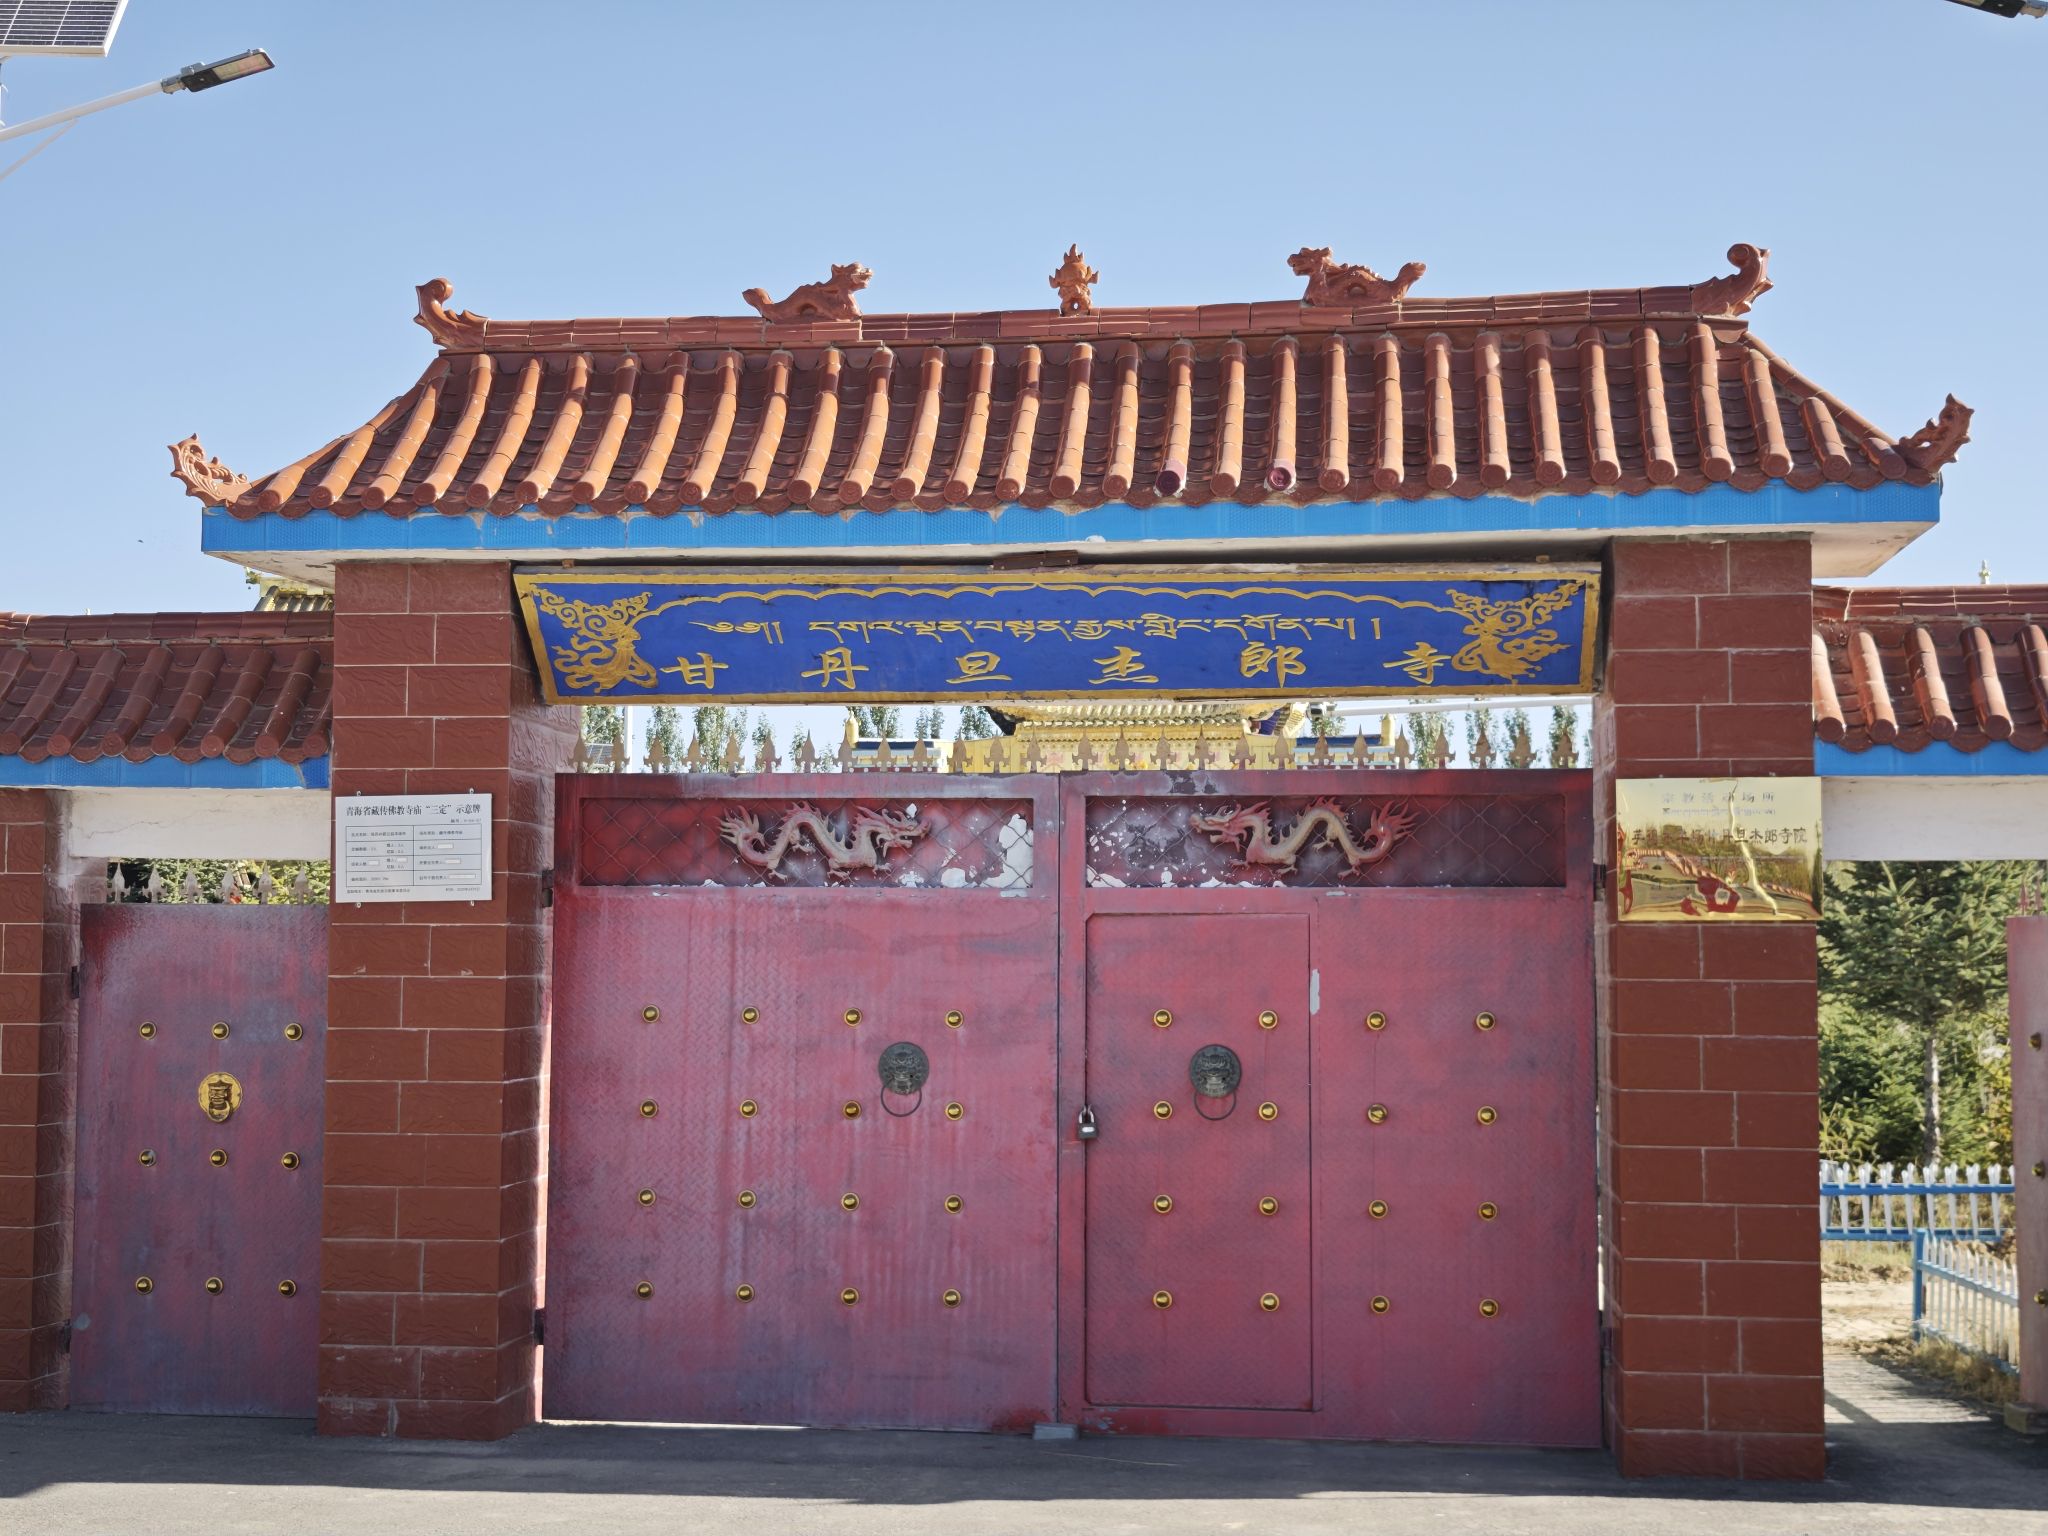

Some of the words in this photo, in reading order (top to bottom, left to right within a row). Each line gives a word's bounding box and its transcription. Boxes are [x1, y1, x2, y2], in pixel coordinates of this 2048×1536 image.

[660, 641, 1451, 690] 甘丹旦杰郎寺
